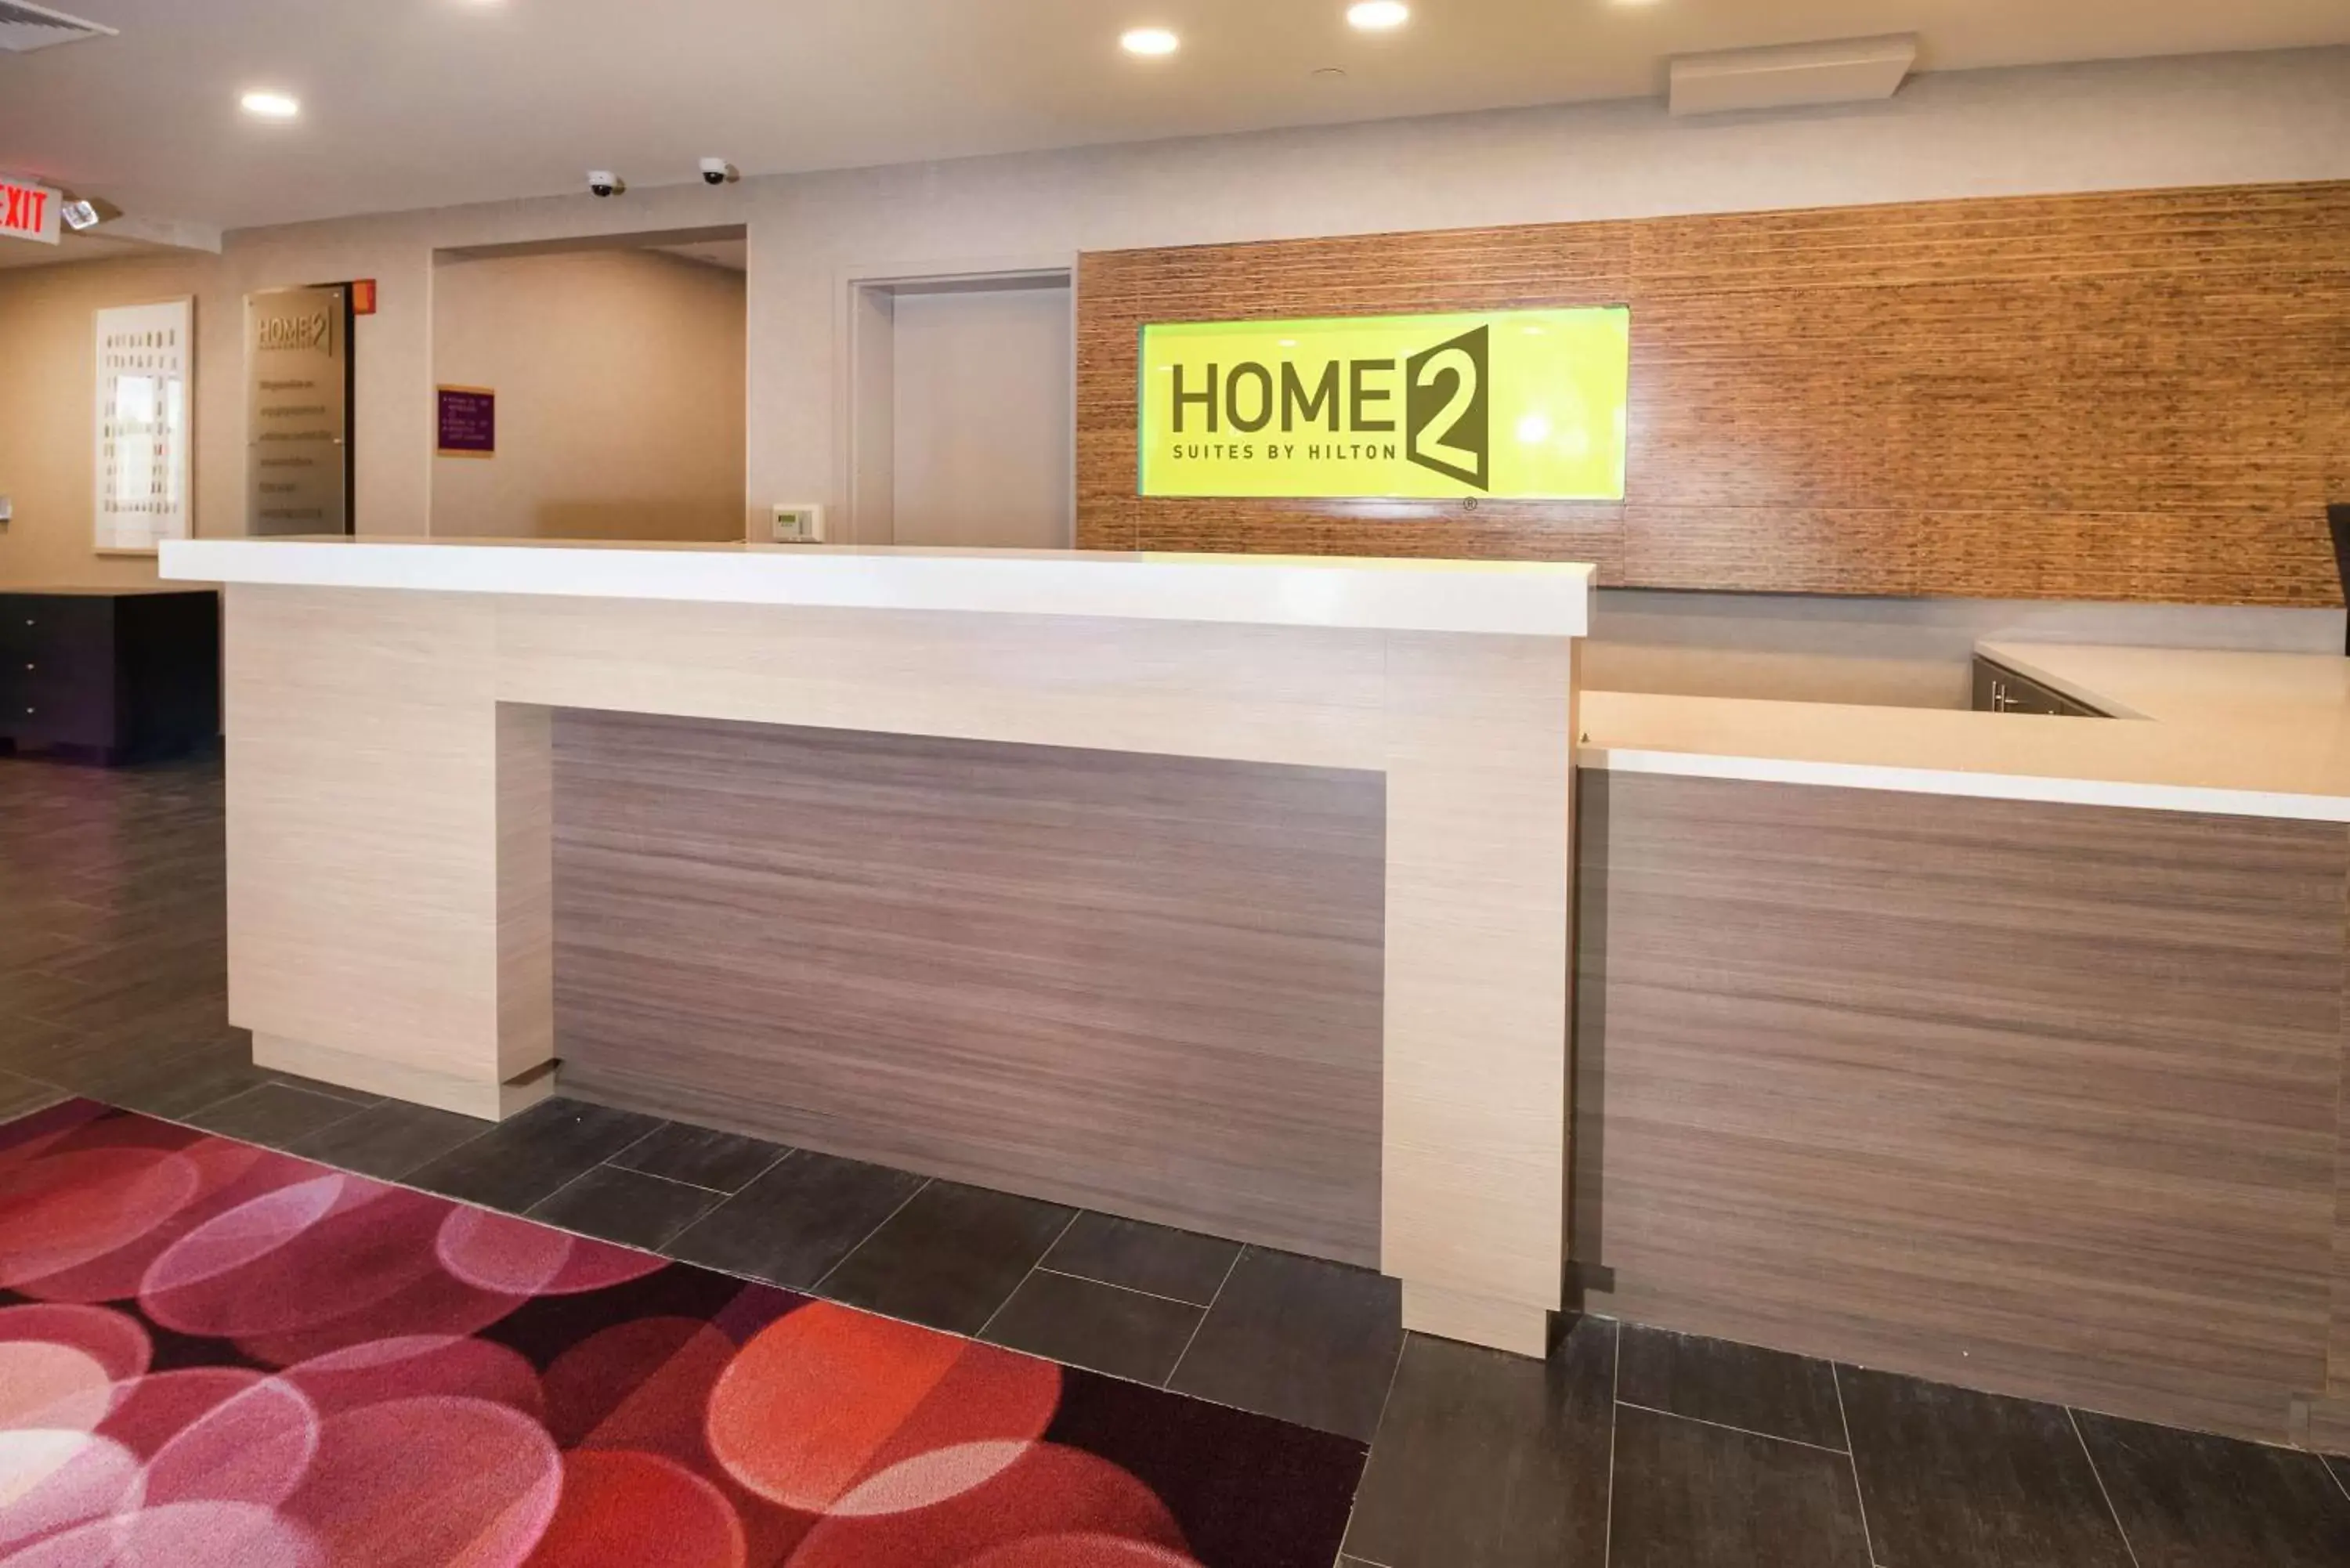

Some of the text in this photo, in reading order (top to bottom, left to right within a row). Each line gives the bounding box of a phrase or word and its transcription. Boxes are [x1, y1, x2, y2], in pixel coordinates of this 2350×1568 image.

[0, 185, 47, 233] XIT
[1173, 444, 1396, 459] SUITES BY HILTON
